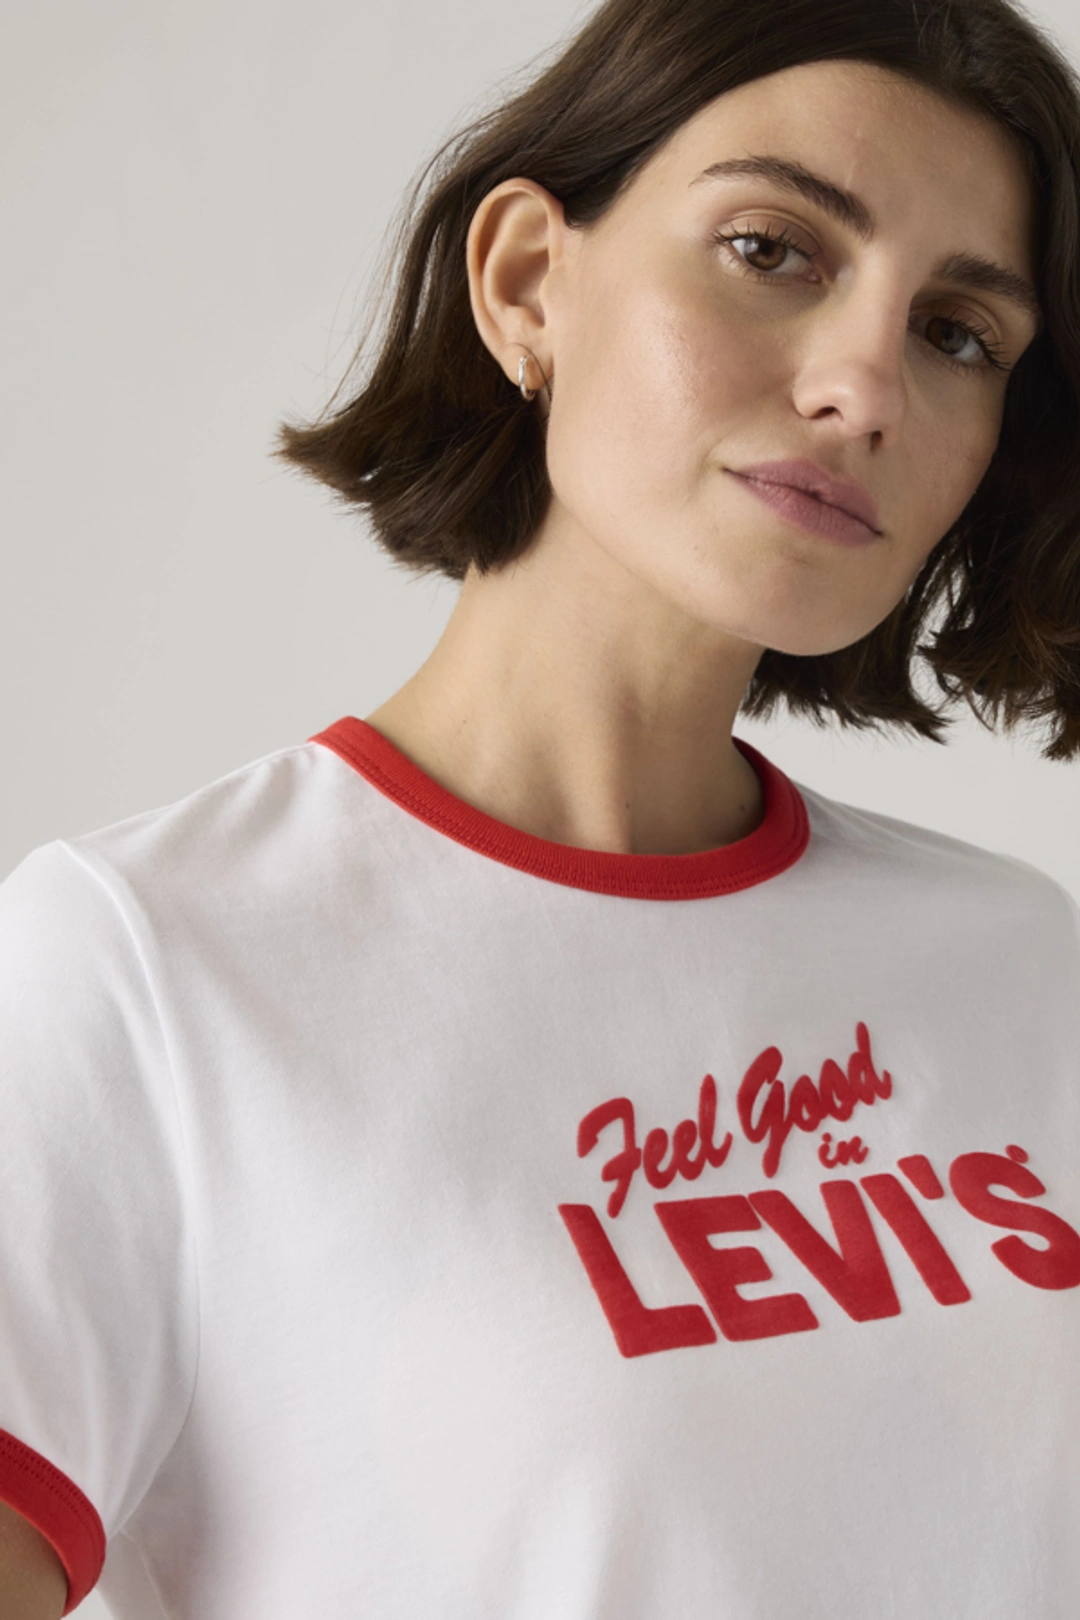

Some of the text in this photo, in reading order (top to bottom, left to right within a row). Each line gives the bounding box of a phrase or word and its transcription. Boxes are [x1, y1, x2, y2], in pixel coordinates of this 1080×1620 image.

[577, 1021, 893, 1218] Feel Good
[818, 1132, 869, 1169] in
[558, 1151, 1080, 1359] LEVI'S
